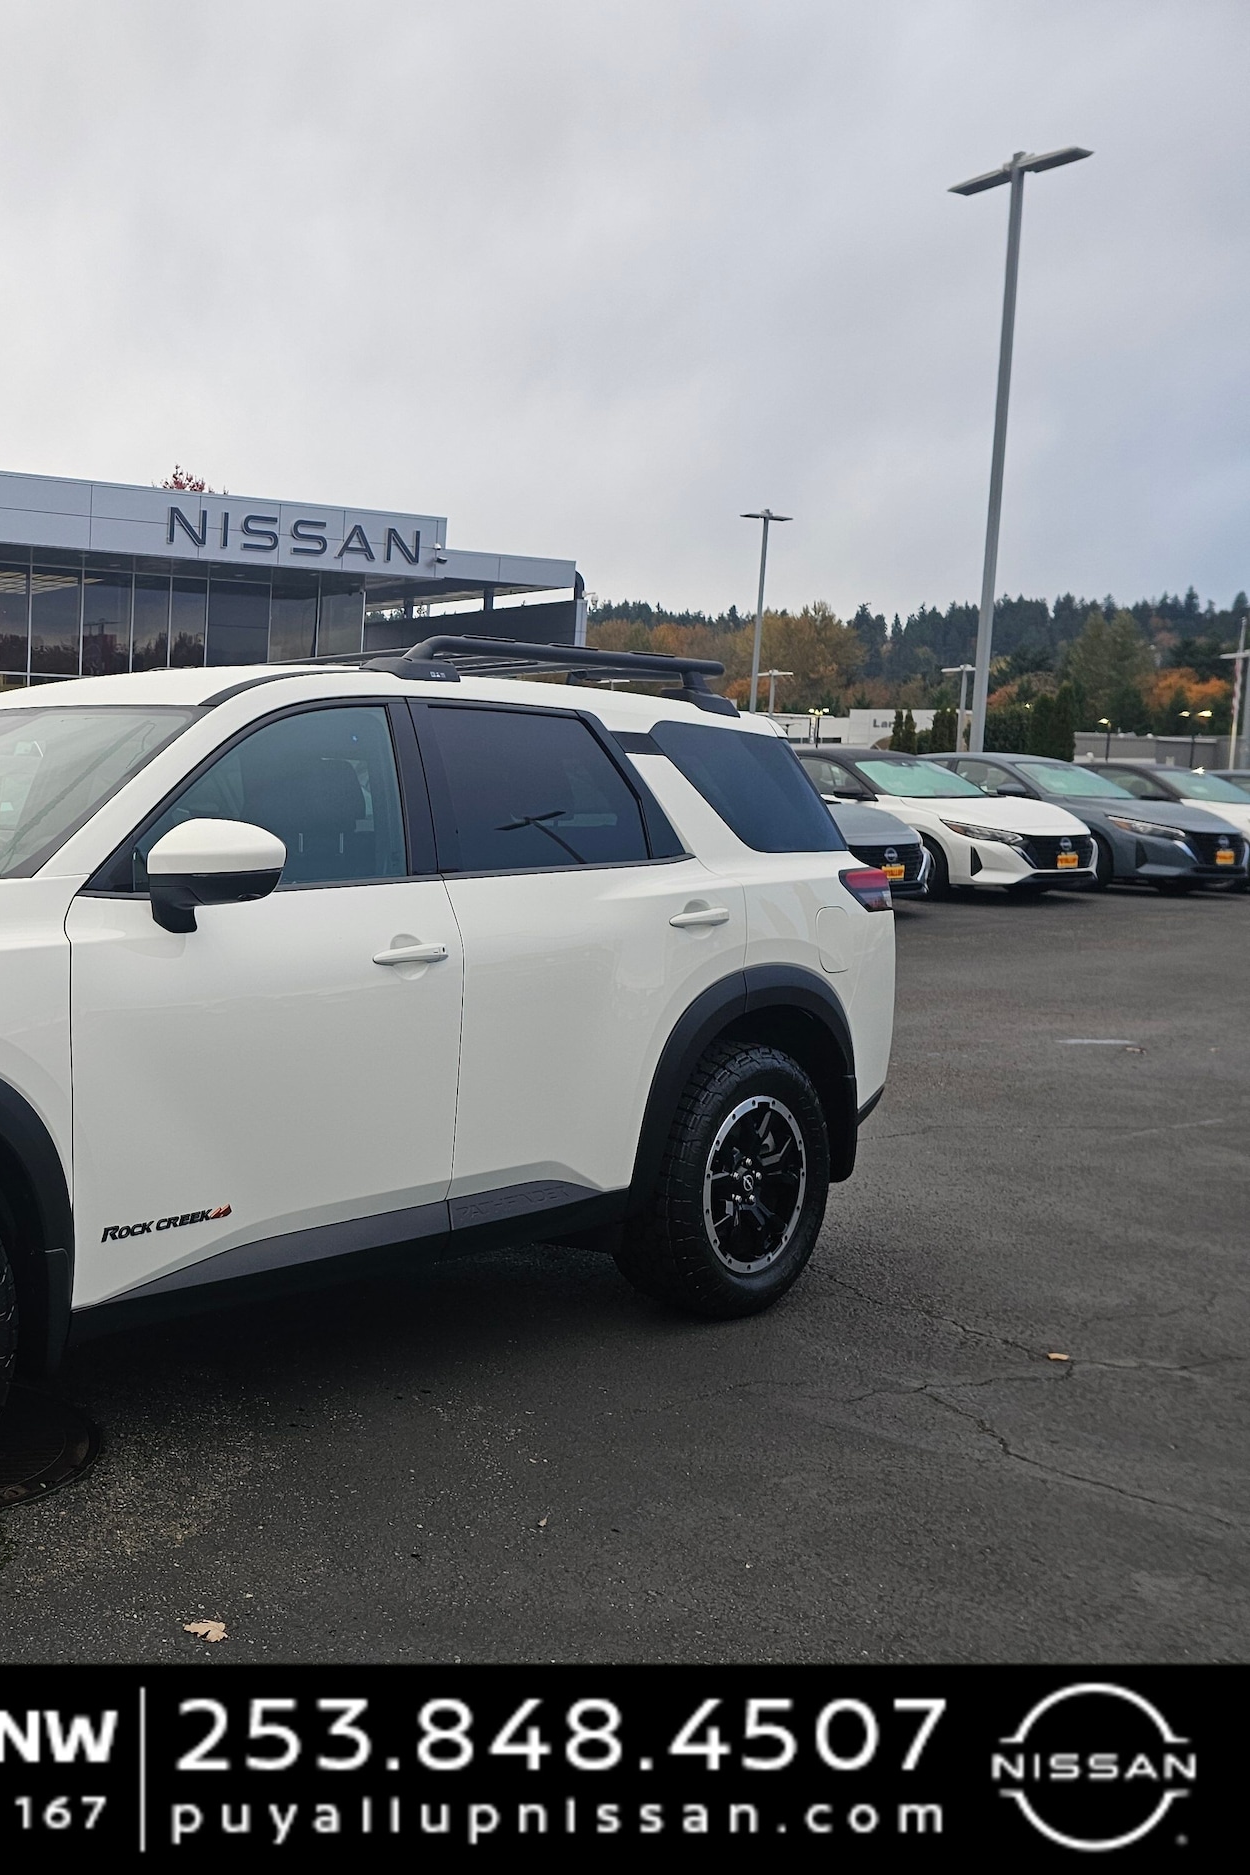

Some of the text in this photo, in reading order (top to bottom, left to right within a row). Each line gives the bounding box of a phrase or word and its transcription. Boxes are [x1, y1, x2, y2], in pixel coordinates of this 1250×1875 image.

[167, 506, 421, 565] NISSAN
[101, 1208, 213, 1243] ROCK CREEK
